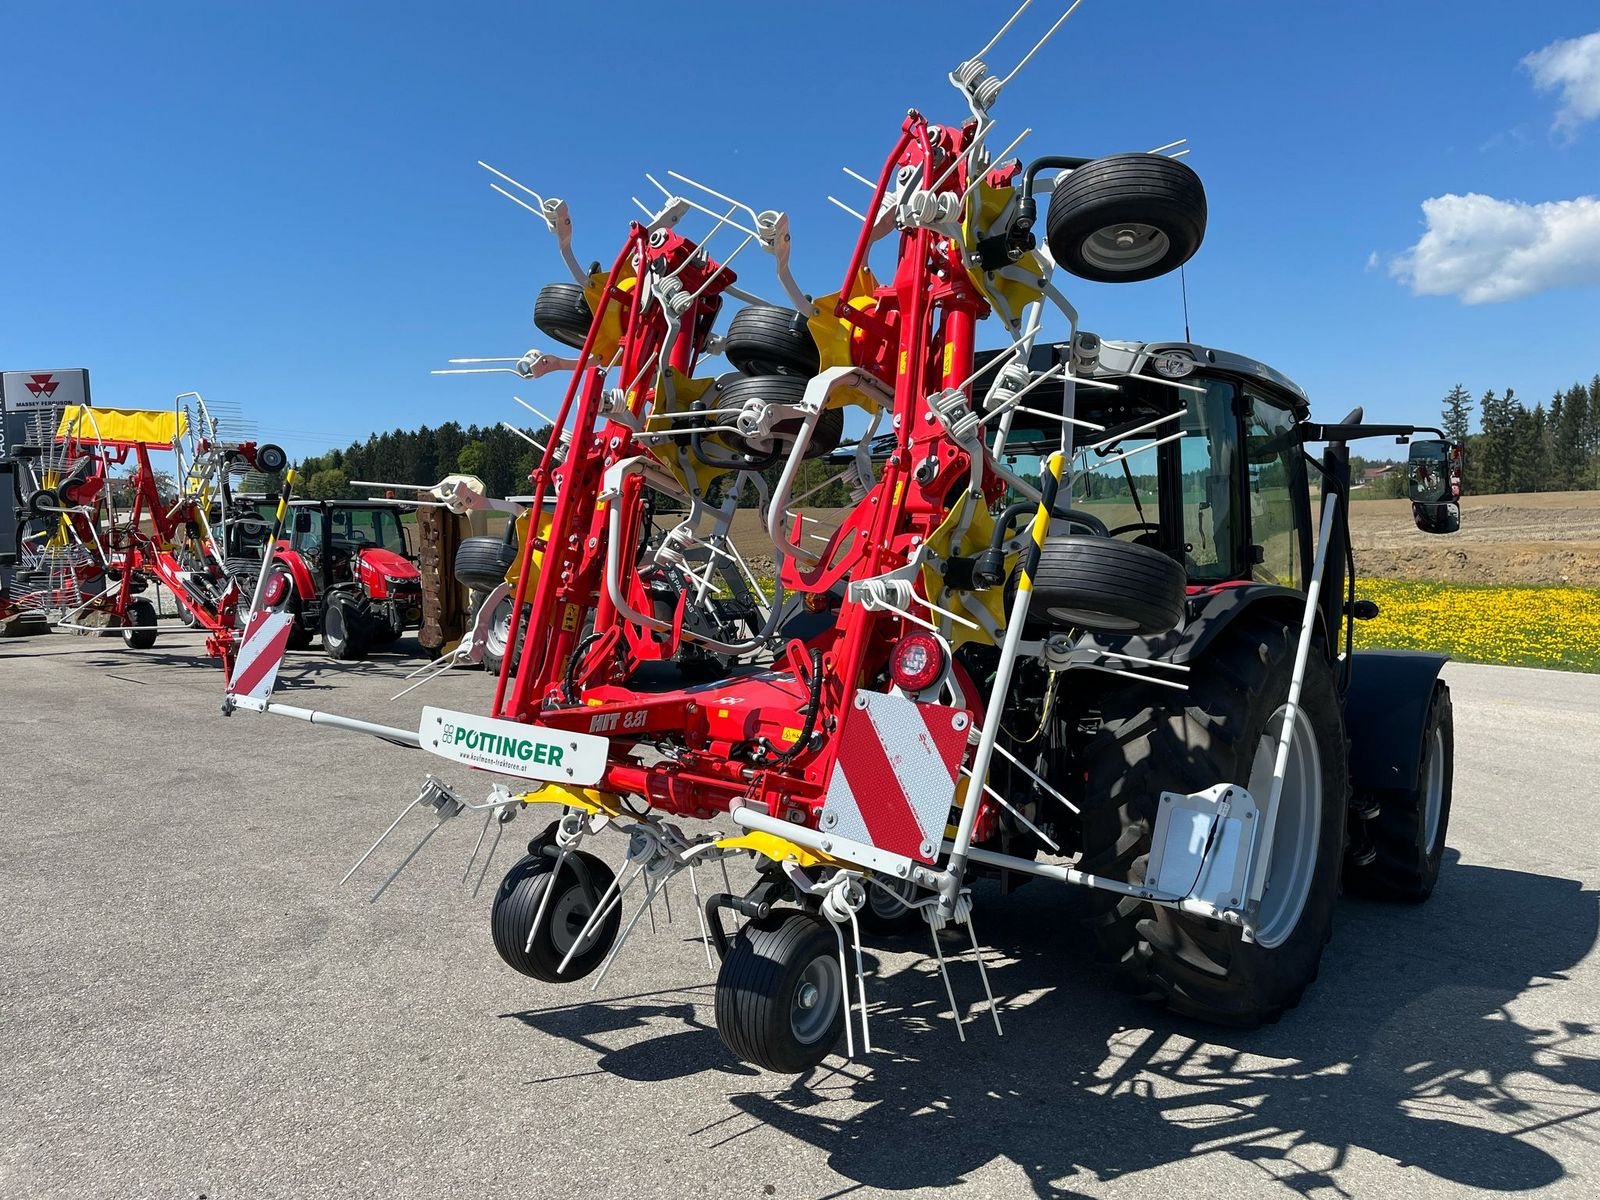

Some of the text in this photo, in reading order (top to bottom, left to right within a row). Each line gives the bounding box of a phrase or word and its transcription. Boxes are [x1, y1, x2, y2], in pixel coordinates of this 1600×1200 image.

[589, 710, 648, 733] HIT 8.81
[454, 727, 564, 767] PÖTTINGER
[460, 752, 527, 772] www.kaufmann-traktoren.at
